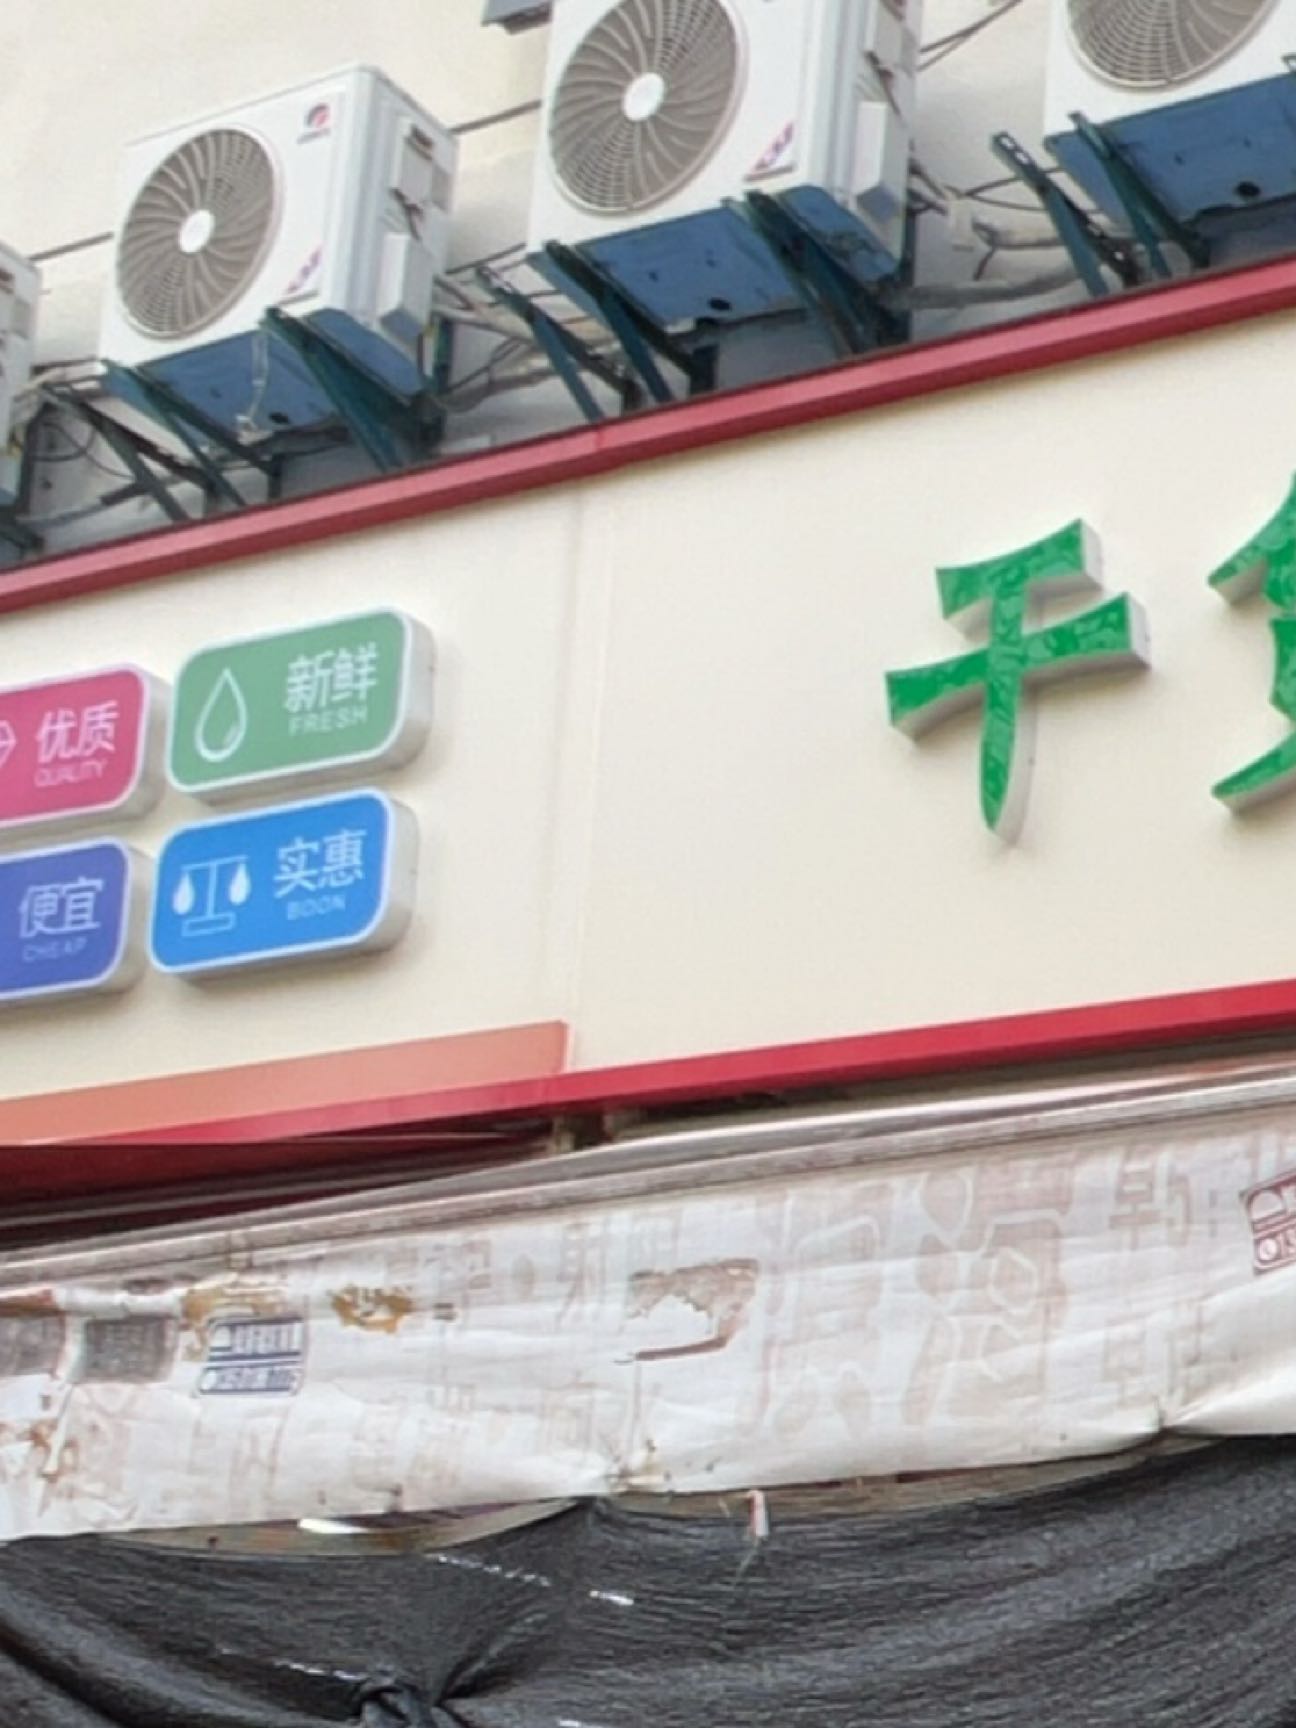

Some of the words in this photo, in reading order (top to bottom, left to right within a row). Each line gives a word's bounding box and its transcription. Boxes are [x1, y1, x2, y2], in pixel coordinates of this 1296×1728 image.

[285, 642, 378, 713] 新鲜
[35, 700, 119, 763] 优质
[289, 705, 368, 736] FRESH
[34, 757, 108, 788] QUALITY
[273, 828, 367, 899] 实惠
[18, 876, 104, 939] 便宜
[22, 936, 87, 963] CHEAP
